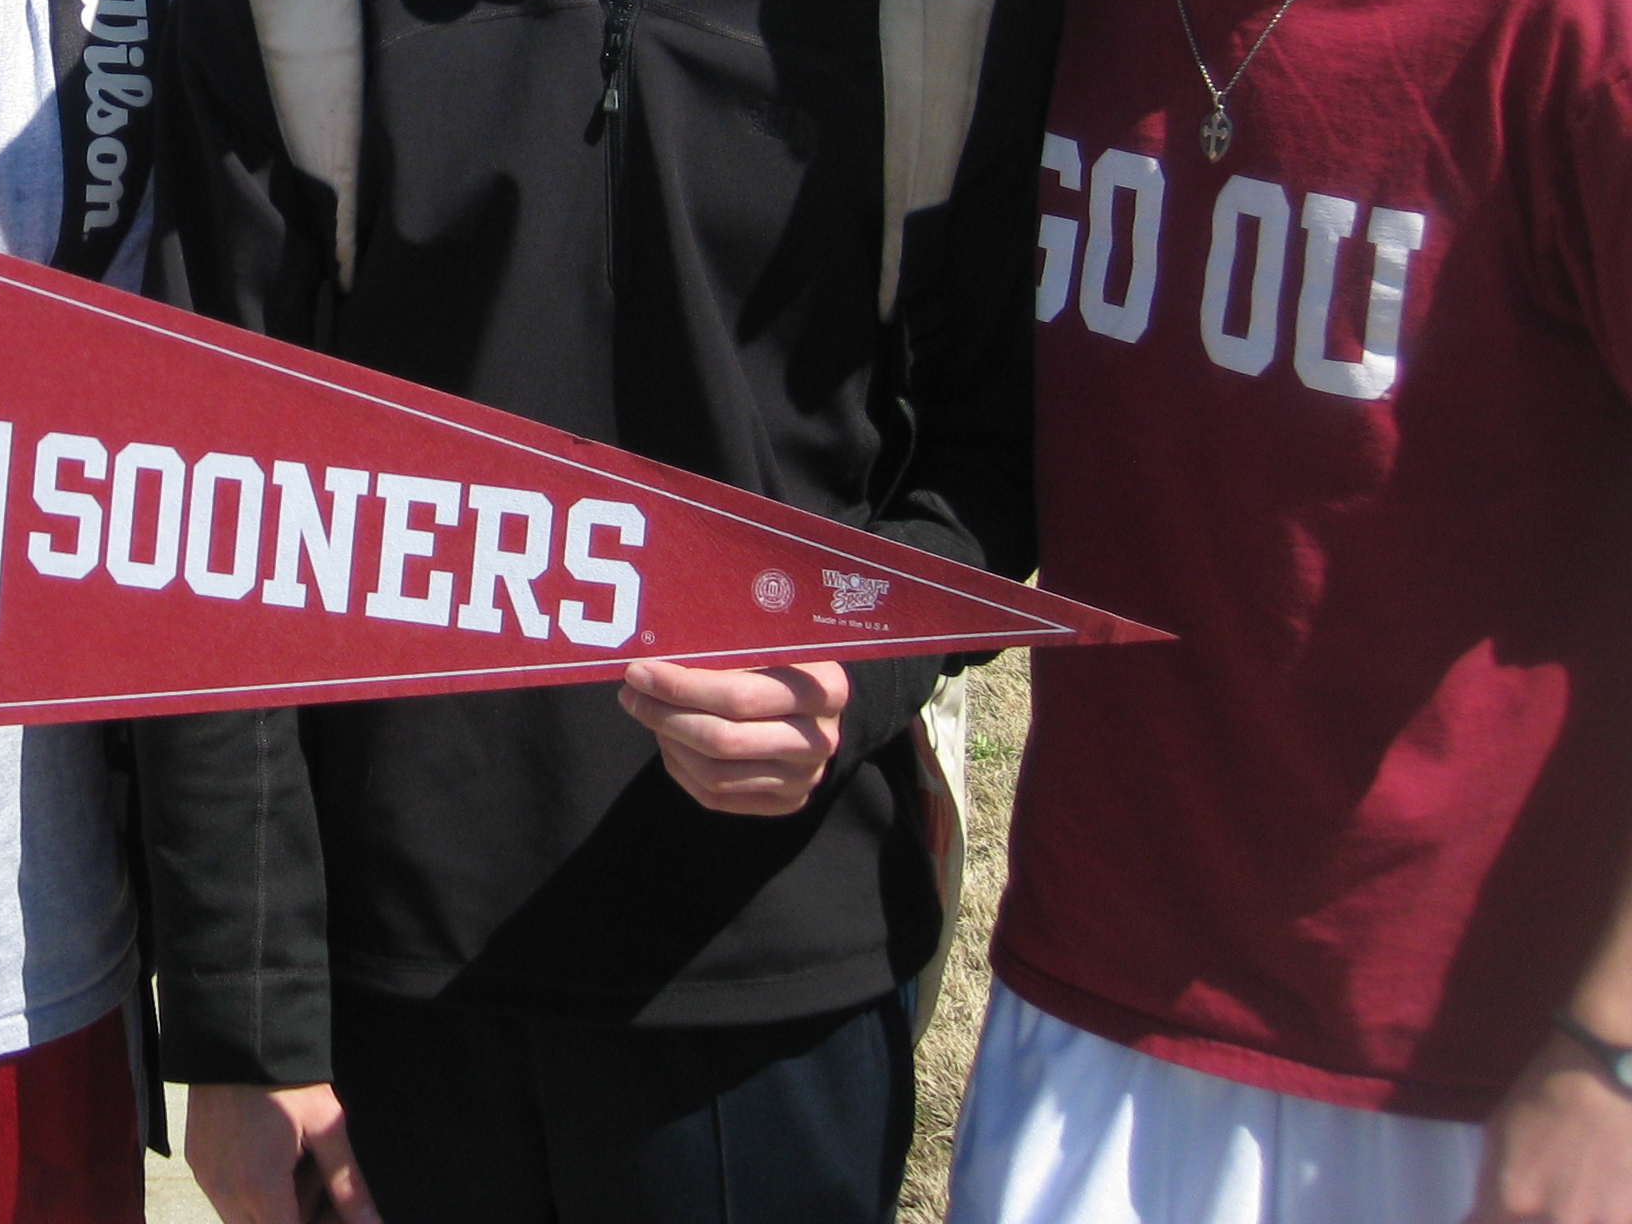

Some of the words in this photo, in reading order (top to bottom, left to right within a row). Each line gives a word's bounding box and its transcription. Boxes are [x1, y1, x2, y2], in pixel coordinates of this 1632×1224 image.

[1200, 175, 1426, 400] OU
[28, 431, 646, 649] SOONERS
[812, 614, 837, 625] Made
[849, 619, 863, 628] the
